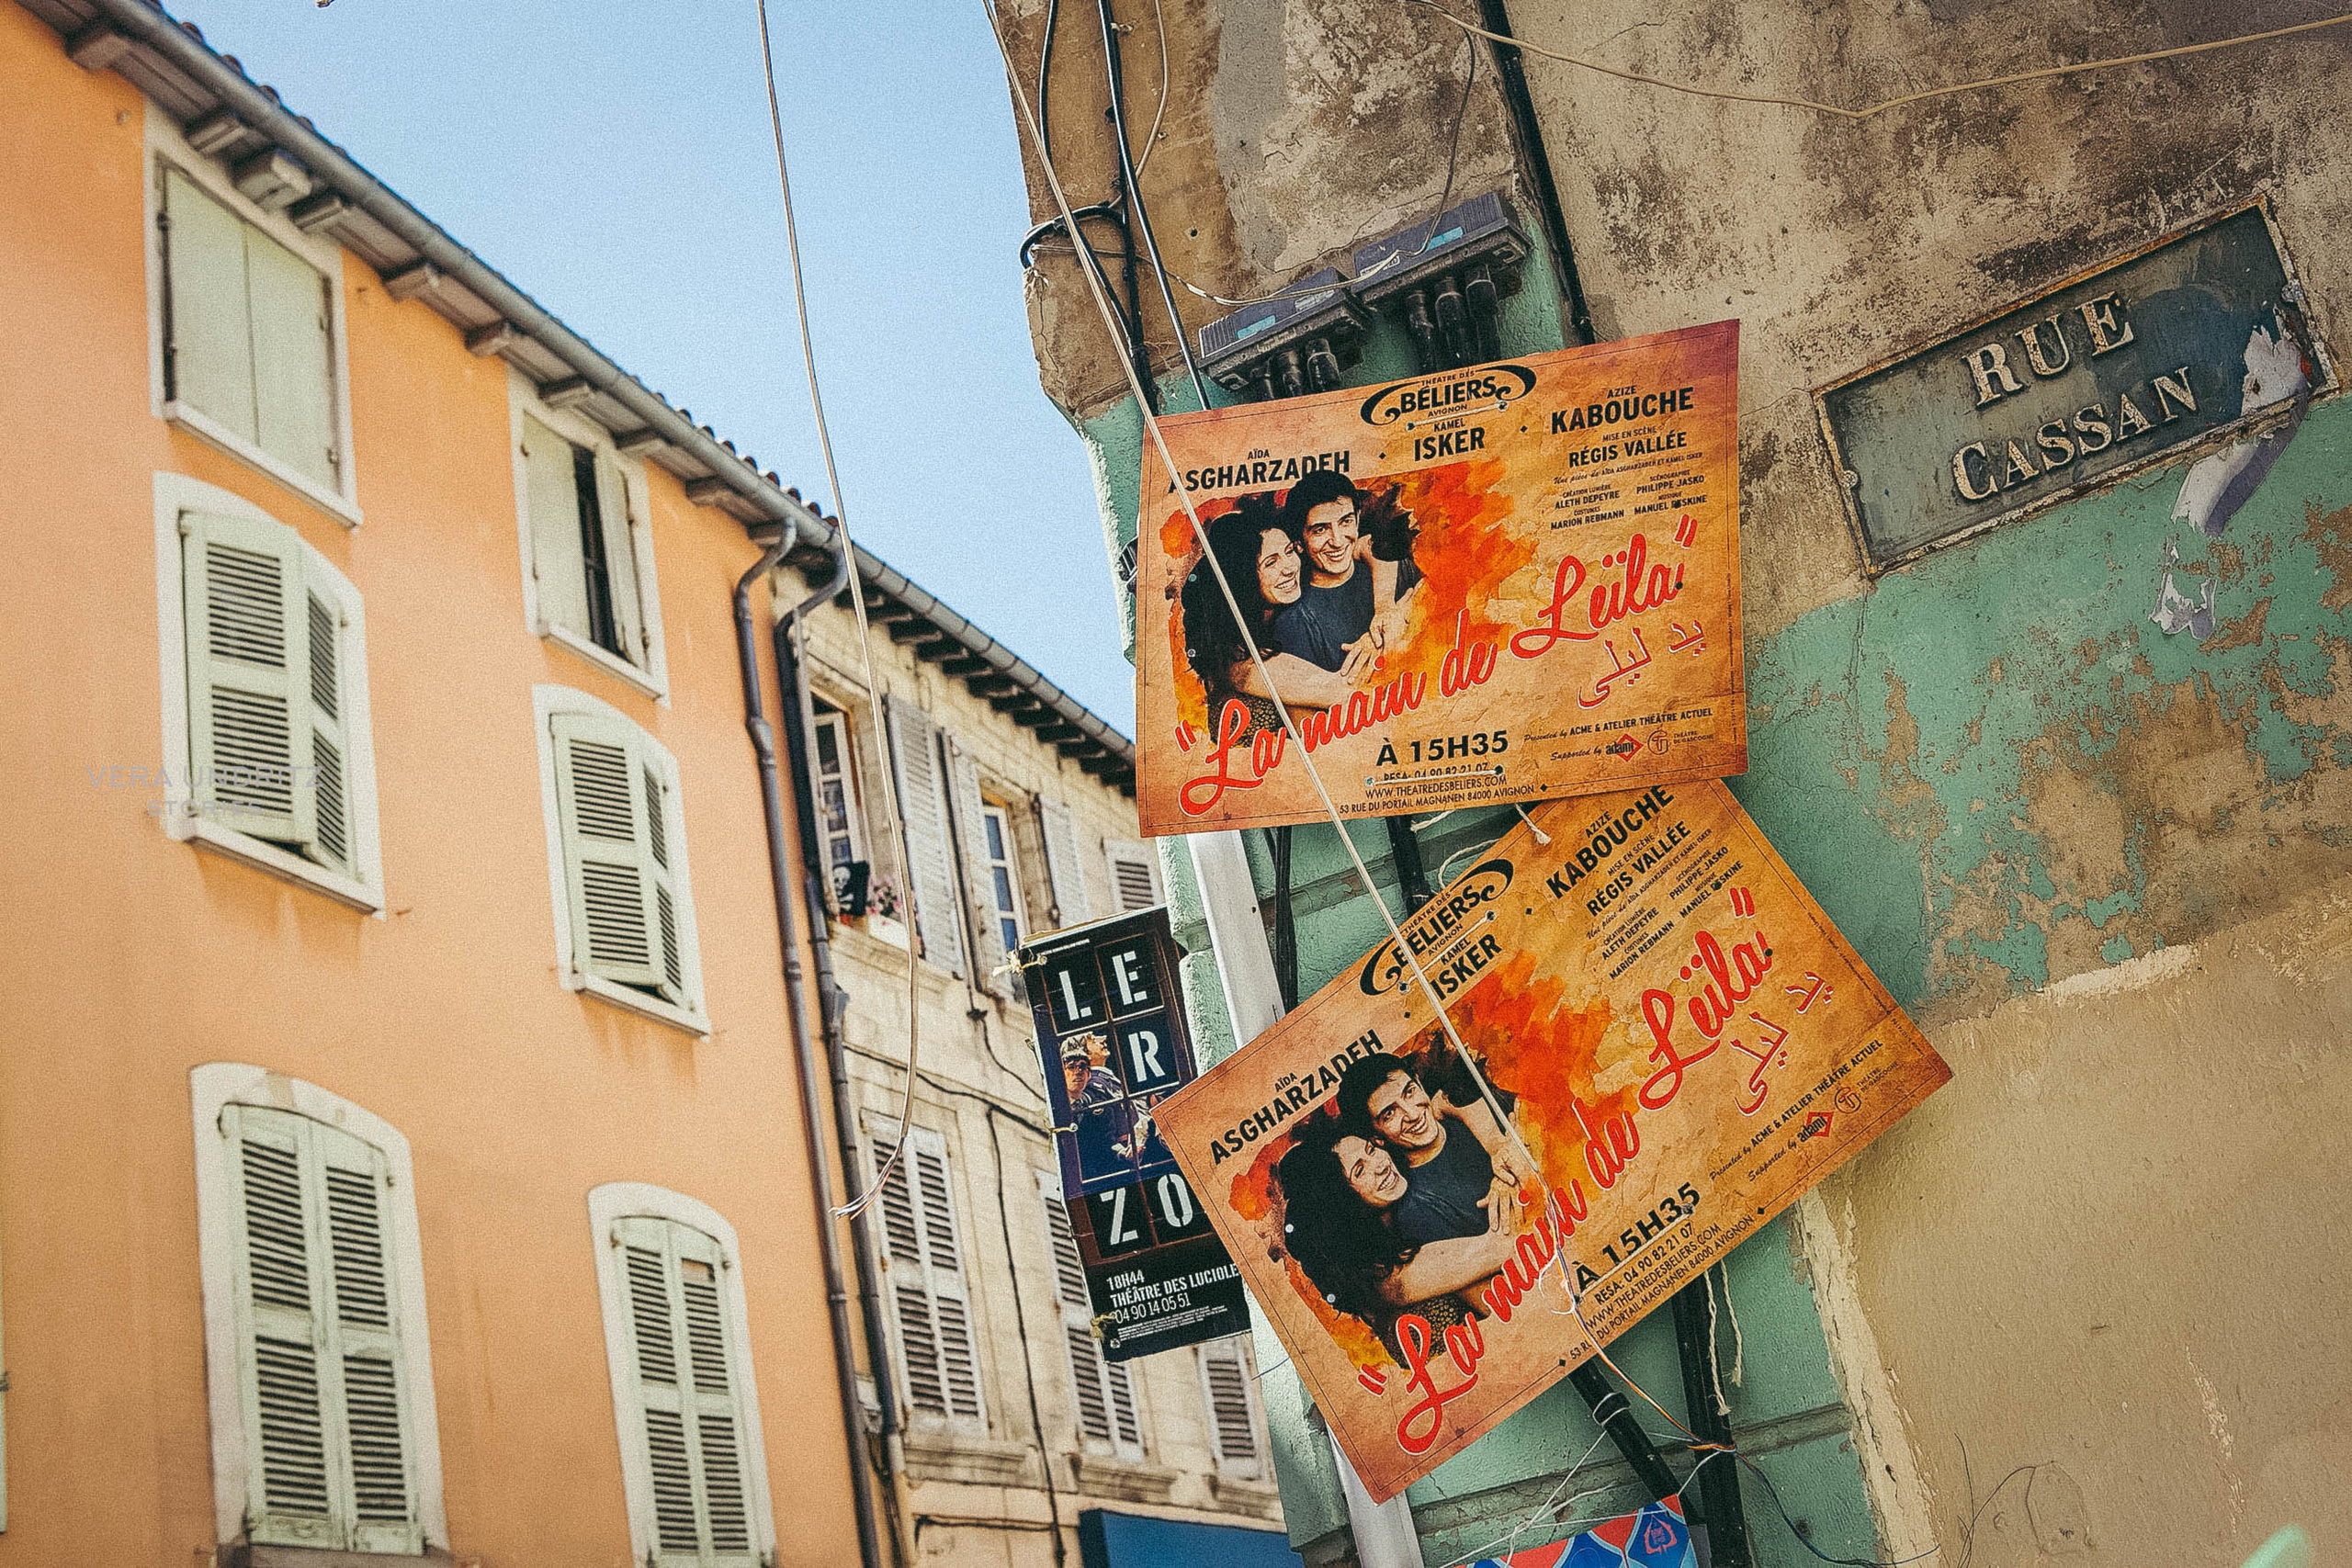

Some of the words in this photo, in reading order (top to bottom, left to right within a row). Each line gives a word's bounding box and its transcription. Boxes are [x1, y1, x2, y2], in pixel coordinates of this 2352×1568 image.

[1962, 289, 2136, 410] RUE
[1400, 376, 1497, 413] BÉLIERS
[1607, 385, 1637, 399] AZIZE
[1428, 404, 1467, 417] AVIGNON
[1433, 418, 1465, 432] KAMEL
[1551, 387, 1693, 434] KABOUCHE
[1414, 427, 1485, 461] ISKER
[1569, 443, 1618, 468] RÉGIS
[1624, 430, 1687, 457] VALLÉE
[1602, 432, 1620, 442] MISE
[1622, 430, 1632, 439] EN
[1951, 367, 2199, 502] CASSAN
[1247, 448, 1270, 460] AÏDA
[1555, 497, 1580, 510] ALETH
[1583, 491, 1620, 504] DEPEYRE
[1636, 480, 1674, 494] PHILIPPE
[1677, 475, 1705, 488] JASKO
[1551, 517, 1582, 531] MARION
[1585, 509, 1624, 525] REBMANN
[1634, 502, 1668, 515] MANUEL
[1668, 620, 1707, 657] يد
[1300, 656, 1426, 753] main
[1441, 608, 1498, 698] de
[1569, 725, 1592, 736] ACME
[1594, 724, 1600, 732] &
[1602, 718, 1637, 731] ATELIER
[1680, 707, 1713, 720] ACTUEL
[1375, 737, 1398, 766] À
[1409, 730, 1509, 762] 15H35
[1550, 748, 1590, 761] Supported
[1593, 746, 1602, 756] by
[1340, 804, 1350, 814] 53
[1351, 802, 1366, 813] RUE
[1368, 801, 1380, 812] DU
[1382, 798, 1413, 809] PORTAIL
[1416, 793, 1464, 807] MAGNANEN
[1467, 790, 1491, 801] 84000
[1494, 784, 1534, 798] AVIGNON
[1365, 776, 1507, 798] WWW.THEATREDESBELIERS.COM
[1545, 785, 1675, 899] KABOUCHE
[1585, 810, 1612, 839] AZIZE
[1586, 871, 1634, 917] RÉGIS
[1632, 820, 1691, 874] VALLÉE
[1607, 860, 1623, 876] MISE
[1623, 851, 1634, 863] EN
[1669, 867, 1704, 900] PHILIPPE
[1703, 846, 1728, 871] JASKO
[1679, 889, 1712, 919] MANUEL
[1428, 923, 1464, 956] AVIGNON
[1440, 937, 1472, 965] KAMEL
[1601, 936, 1626, 960] ALETH
[1624, 907, 1659, 939] DEPEYRE
[1609, 952, 1639, 980] MARION
[1637, 919, 1675, 954] REBMANN
[1430, 933, 1502, 1001] ISKER
[1784, 971, 1835, 1014] يد
[1209, 1028, 1384, 1166] ASGHARZADEH
[1274, 1072, 1298, 1093] AÏDA
[1750, 1124, 1774, 1148] ACME
[1773, 1119, 1782, 1129] &
[1781, 1092, 1815, 1123] ATELIER
[1849, 1039, 1883, 1067] ACTUEL
[1571, 1096, 1640, 1190] de
[1747, 1146, 1786, 1182] Supported
[1787, 1139, 1797, 1150] by
[1571, 1259, 1601, 1293] À
[1601, 1181, 1701, 1267] 15H35
[1106, 1269, 1145, 1292] 18H44
[1586, 1223, 1723, 1329] WWW.THEATREDESBELIERS.COM
[1594, 1280, 1624, 1305] RESA:
[1623, 1266, 1639, 1283] 04
[1637, 1256, 1652, 1271] 90
[1651, 1245, 1668, 1261] 82
[1666, 1234, 1680, 1251] 21
[1679, 1222, 1693, 1239] 07
[1110, 1282, 1162, 1308] THÉÂTRE
[1163, 1276, 1188, 1294] DES
[1189, 1262, 1241, 1288] LUCIOLE
[1569, 1347, 1581, 1359] 53
[1596, 1326, 1611, 1340] DU
[1610, 1302, 1642, 1331] PORTAIL
[1640, 1264, 1690, 1305] MAGNANEN
[1688, 1246, 1714, 1269] 84000
[1713, 1213, 1755, 1250] AVIGNON
[1114, 1308, 1130, 1324] 04
[1130, 1303, 1147, 1320] 90
[1148, 1300, 1160, 1316] 14
[1161, 1295, 1177, 1312] 05
[1178, 1292, 1192, 1308] 51
